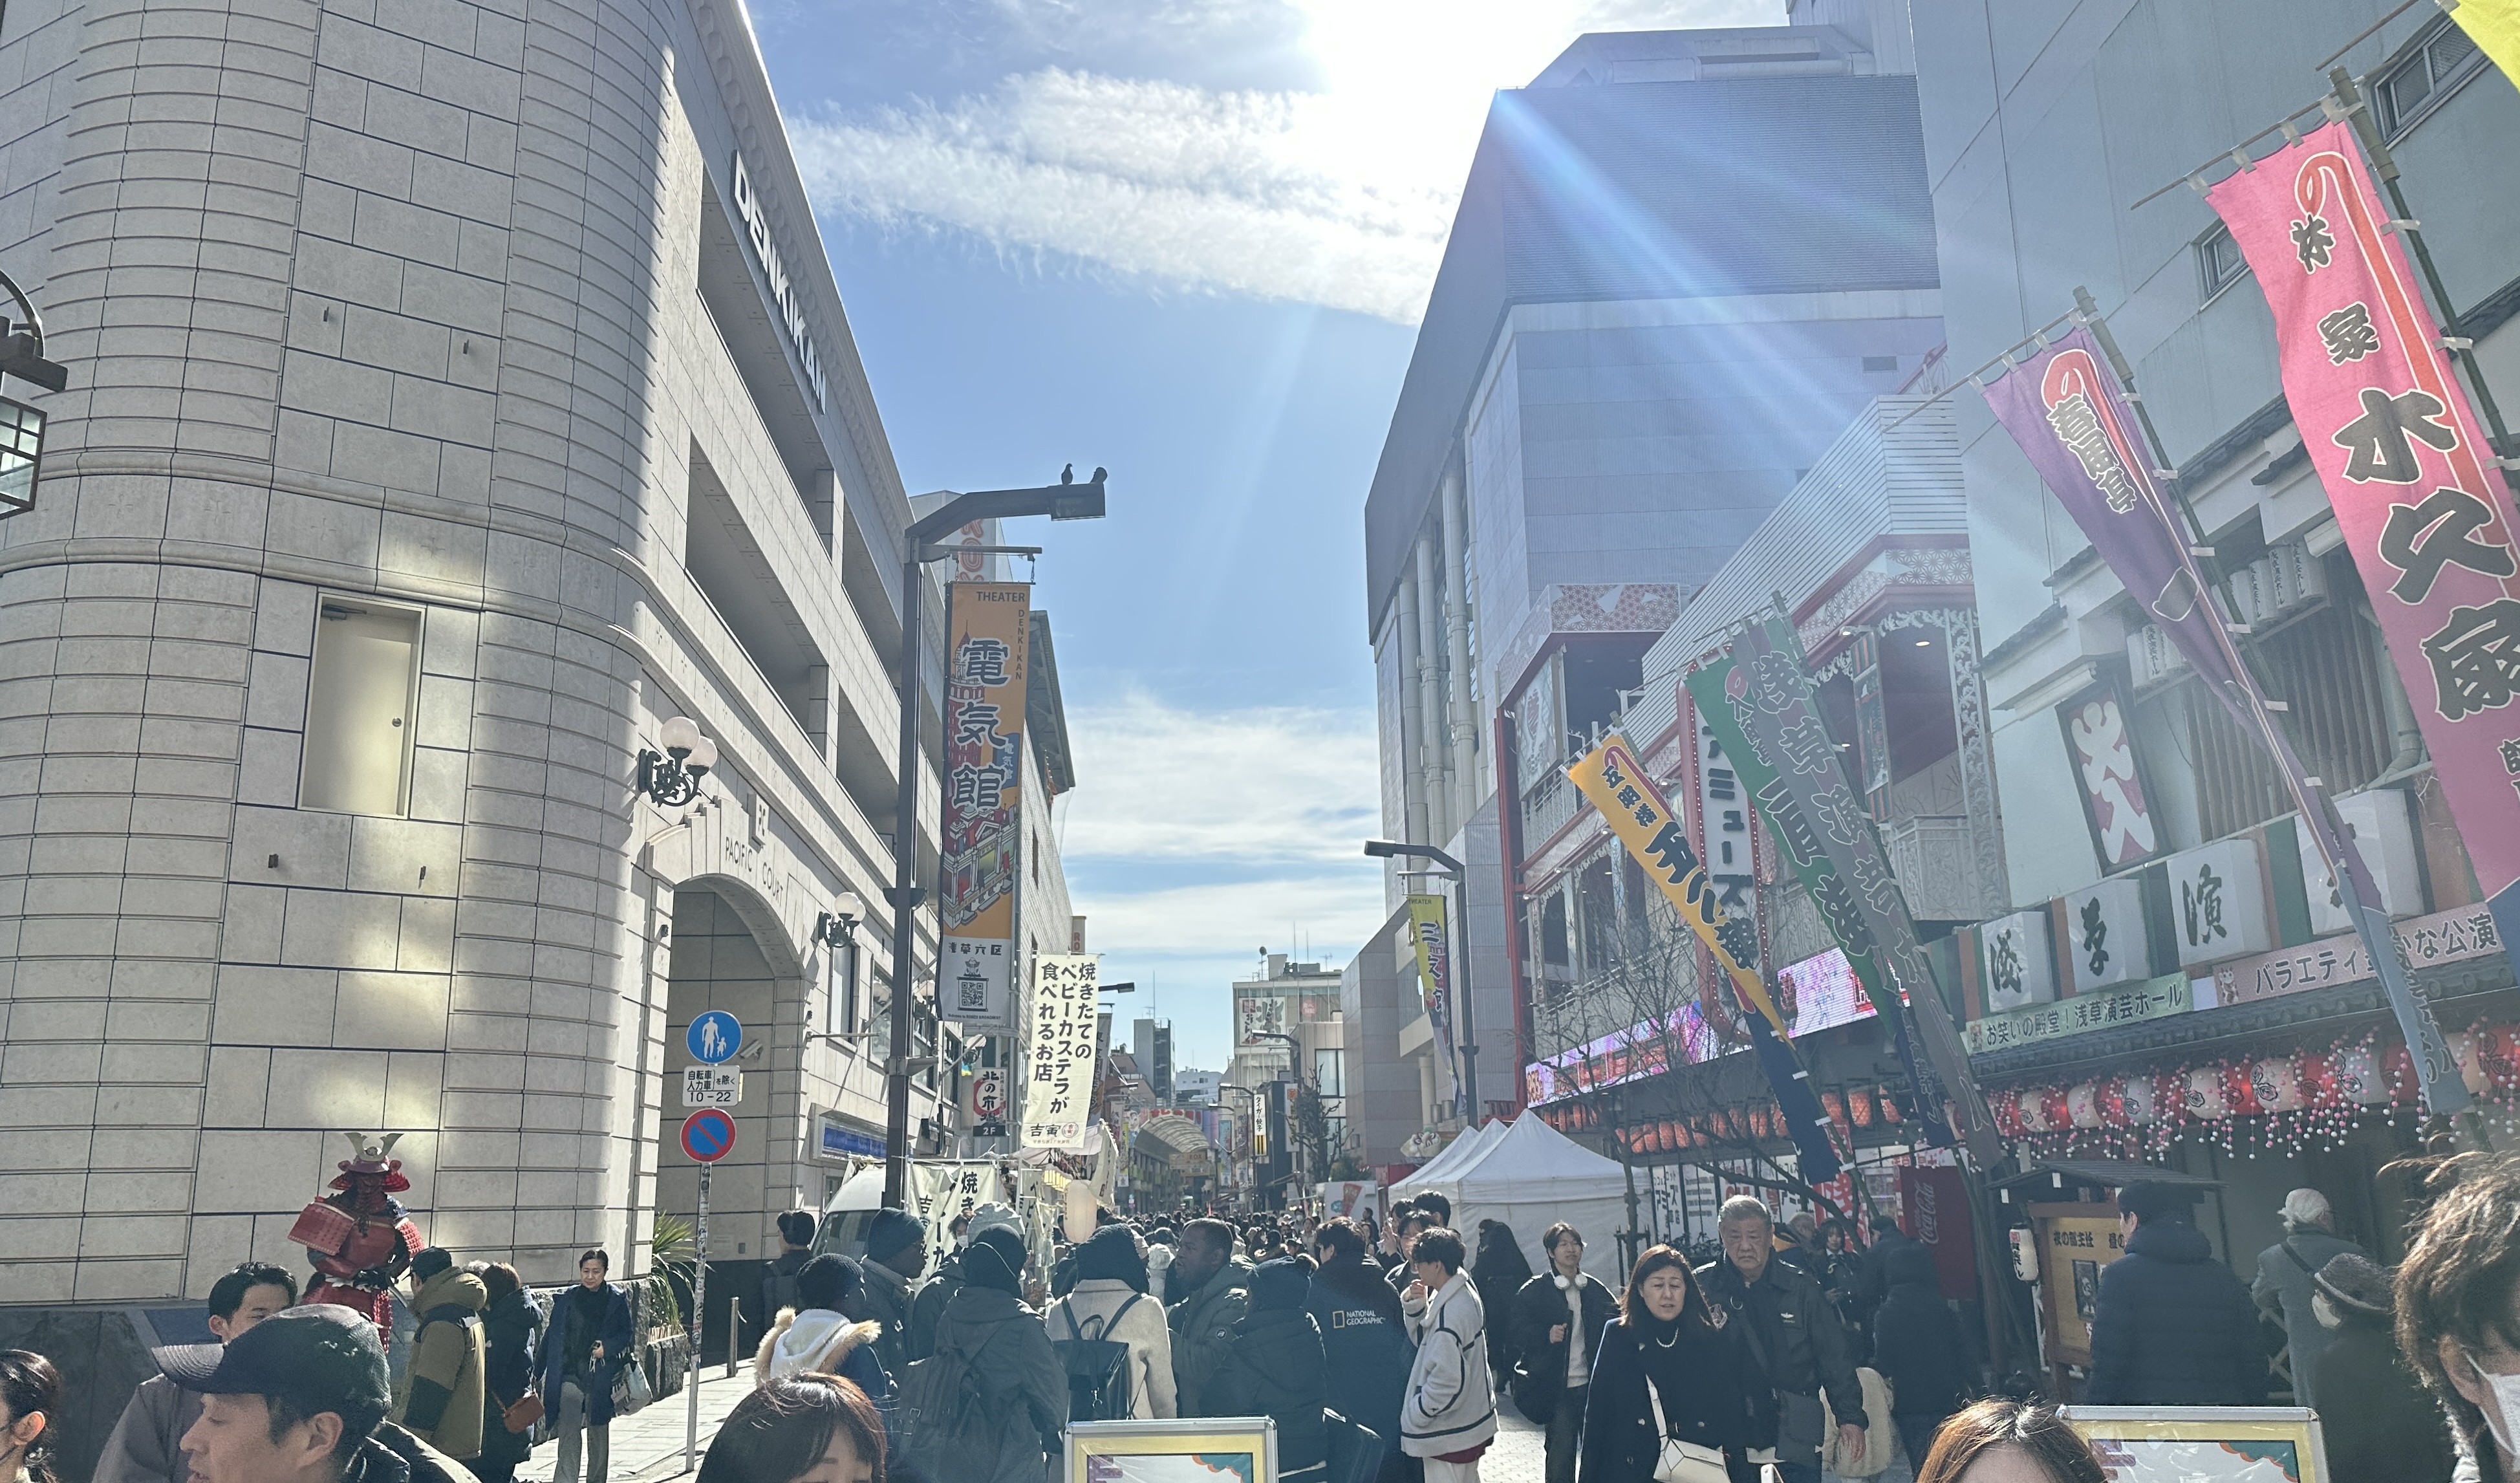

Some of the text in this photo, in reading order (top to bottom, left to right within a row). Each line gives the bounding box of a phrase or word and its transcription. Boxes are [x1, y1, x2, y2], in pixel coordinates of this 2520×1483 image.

[733, 149, 826, 415] DENKIKAN
[976, 591, 1025, 603] THEATER
[1015, 609, 1025, 680] DENKIKAN
[954, 640, 1009, 808] 電気館
[726, 836, 783, 907] PACIFIC COURT
[949, 942, 1002, 955] 浅草六区
[1034, 962, 1059, 1082] 食べれるお店
[1050, 964, 1078, 1114] ベビーカステラが
[1075, 962, 1097, 1059] 焼きたての
[687, 1081, 711, 1091] 人力車
[688, 1070, 713, 1081] 自転車
[716, 1075, 735, 1085] を除く
[1346, 1317, 1384, 1326] GEOGRAPHIC
